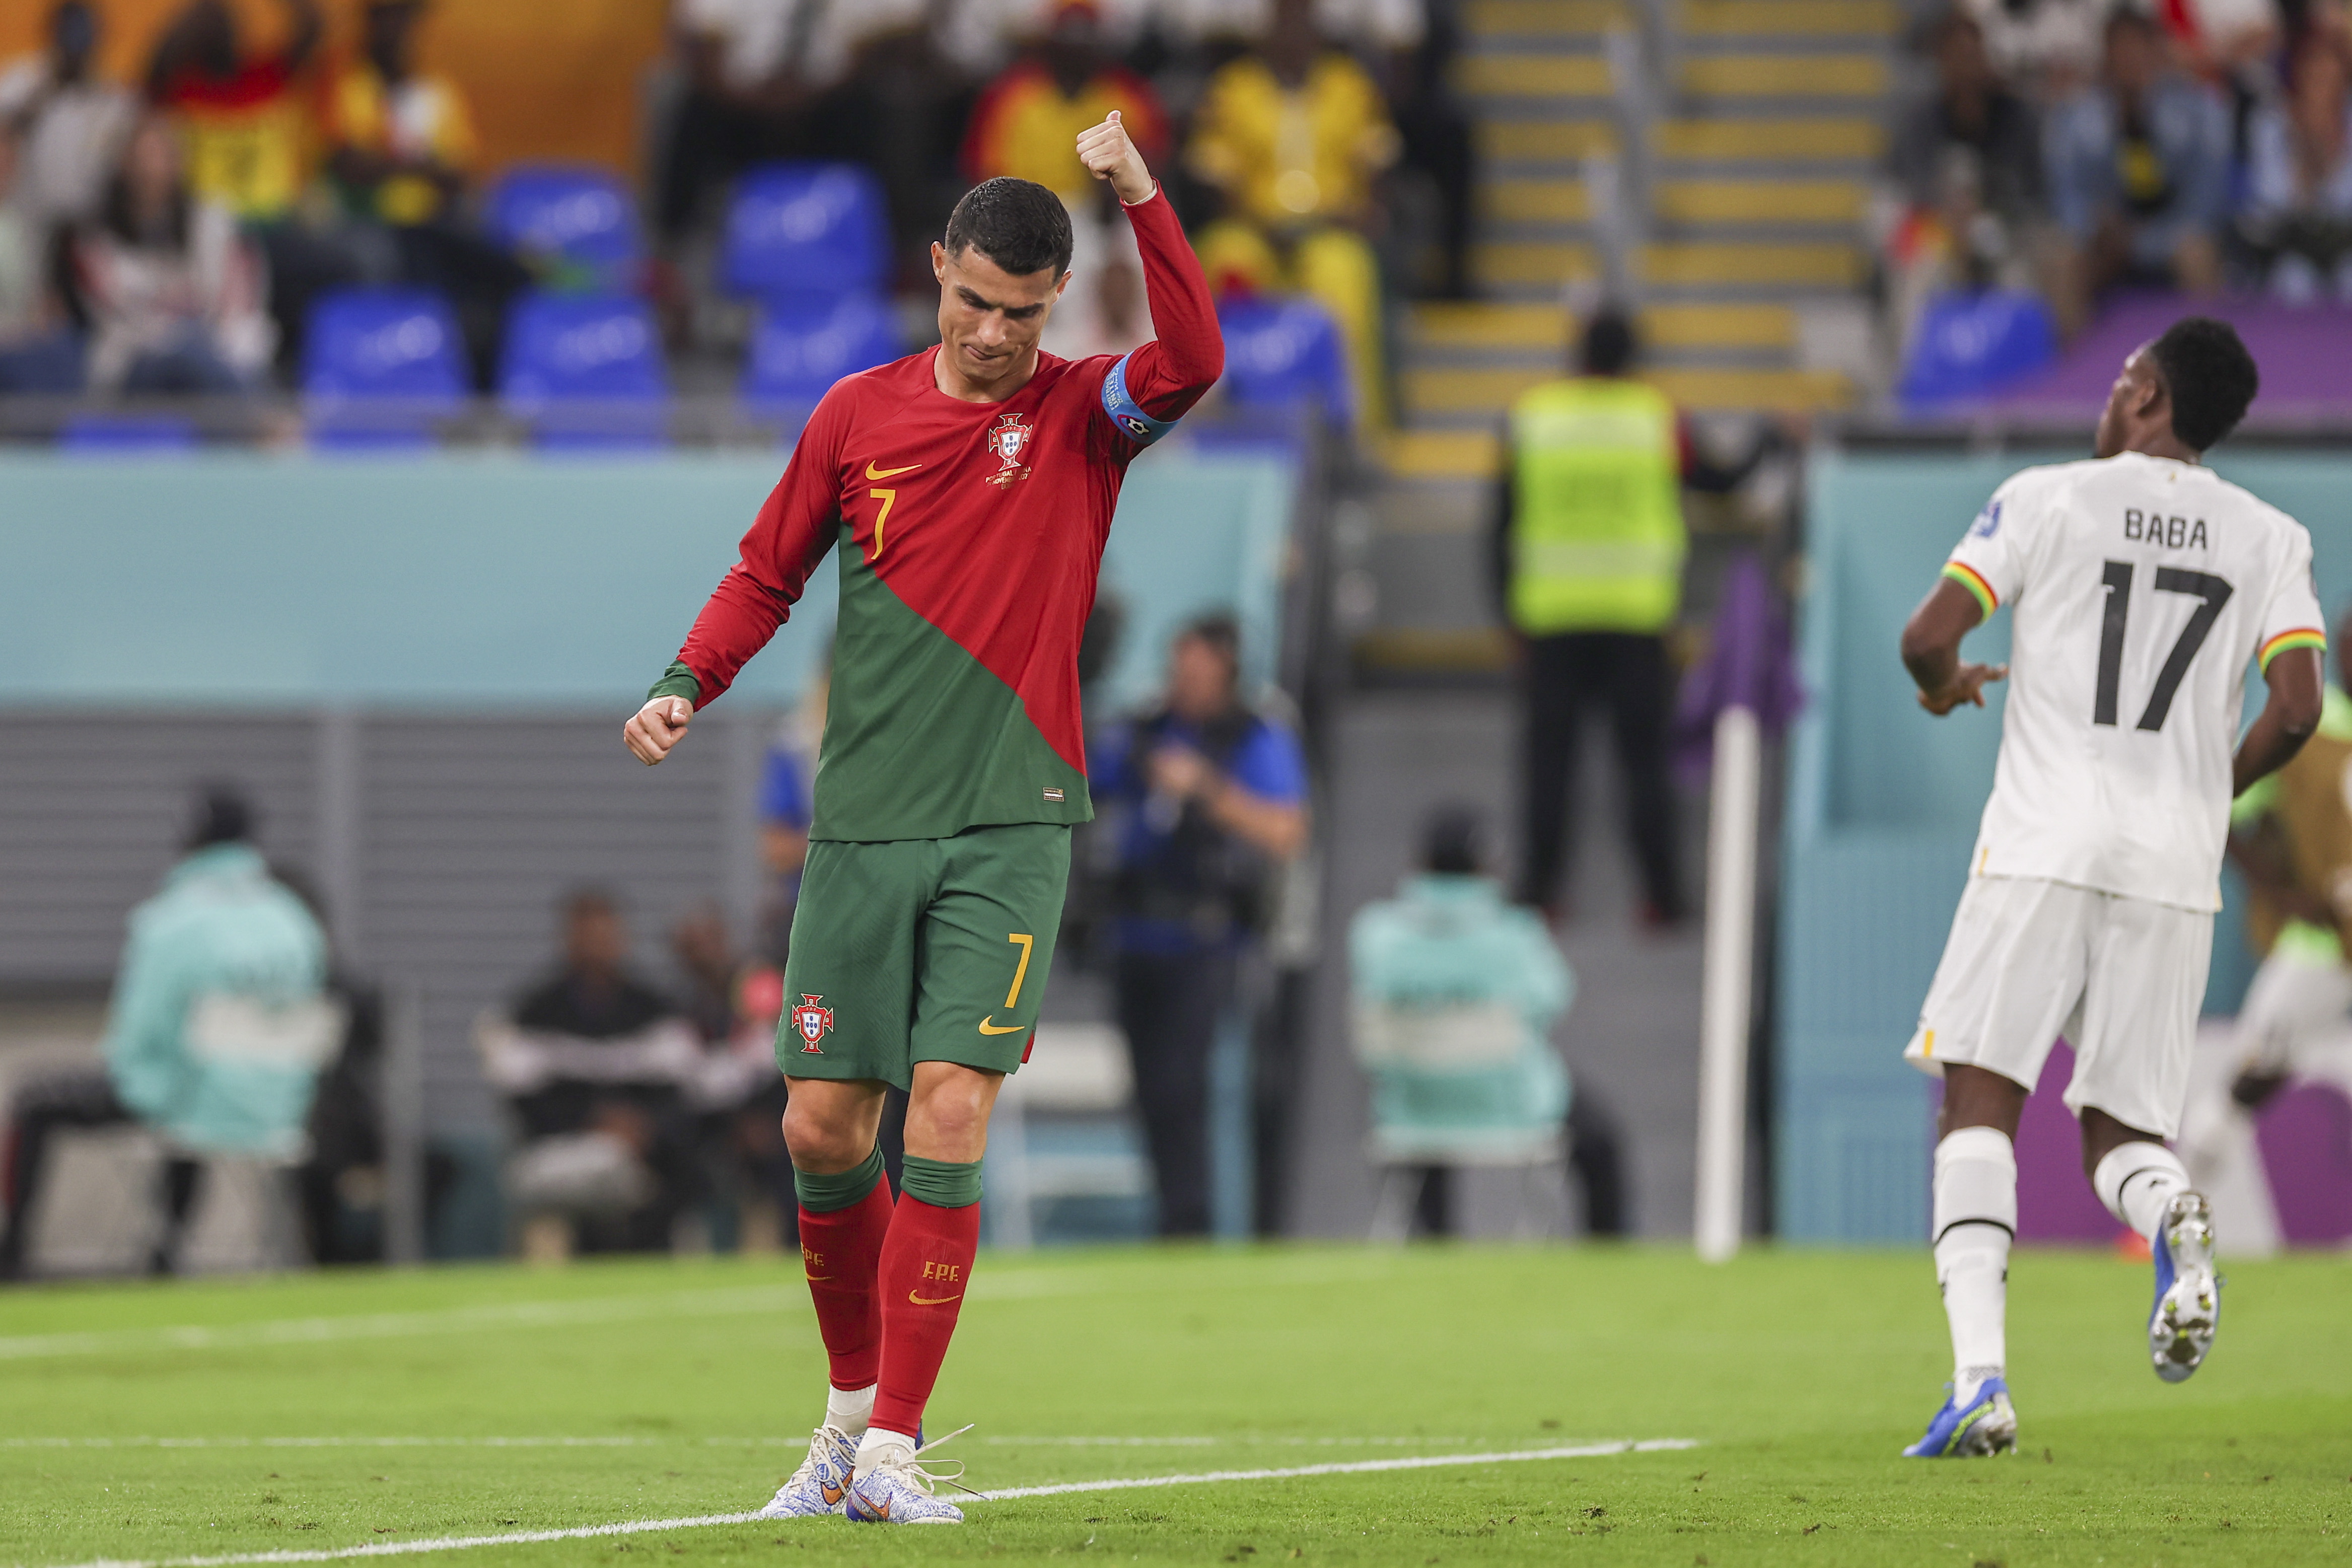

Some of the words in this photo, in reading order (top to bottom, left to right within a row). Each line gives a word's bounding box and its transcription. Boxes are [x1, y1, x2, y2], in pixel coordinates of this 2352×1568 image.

[985, 470, 1014, 483] PORTUGAL
[870, 488, 896, 559] 7
[2125, 509, 2206, 550] BABA
[2094, 560, 2234, 732] 17
[1005, 933, 1033, 1008] 7
